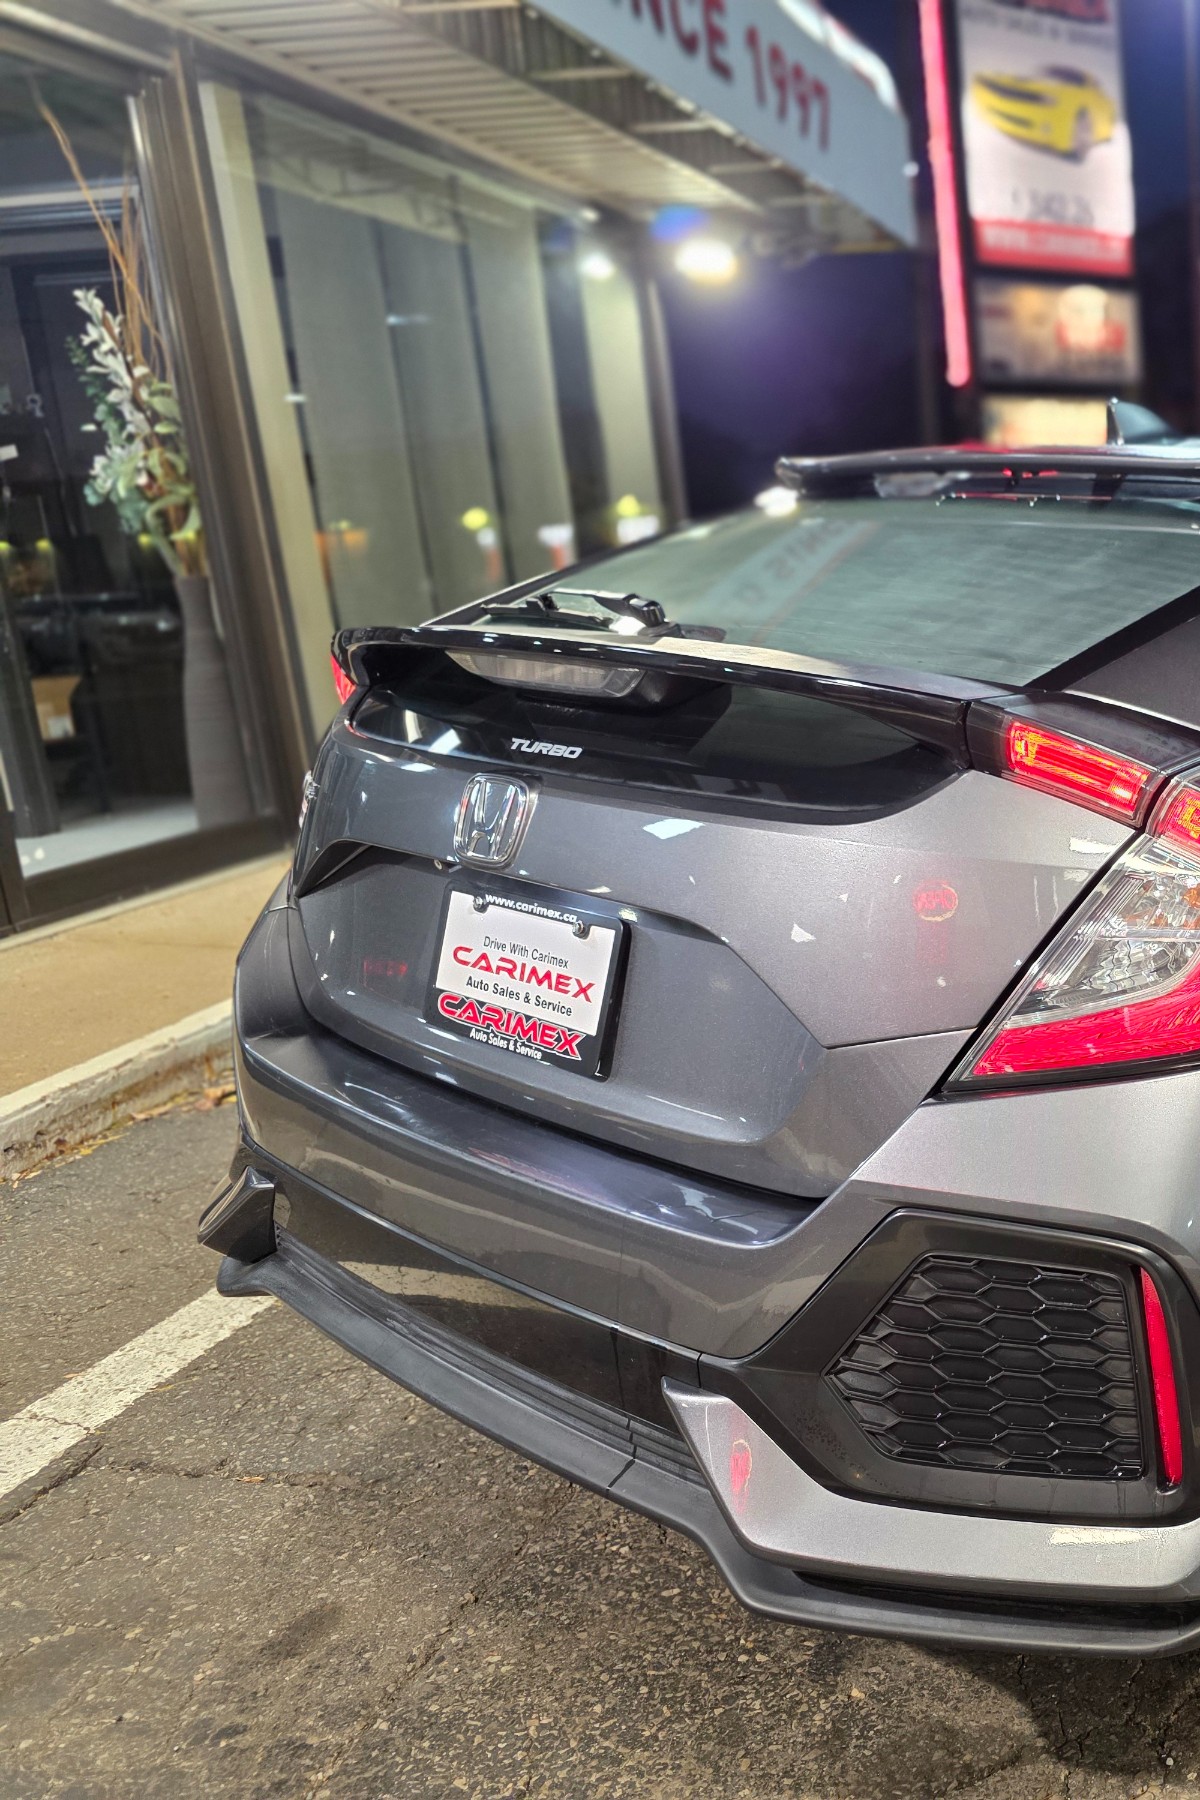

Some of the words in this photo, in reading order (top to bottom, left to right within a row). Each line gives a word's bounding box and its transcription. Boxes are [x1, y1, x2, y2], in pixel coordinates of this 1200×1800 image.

[746, 25, 831, 151] 1997
[511, 737, 583, 759] TURBO
[485, 894, 577, 923] www.carimex.ca
[483, 935, 507, 952] Drive
[509, 941, 529, 959] With
[531, 948, 569, 969] Carimex
[453, 946, 596, 1003] CARIMEX
[466, 976, 489, 992] Auto
[492, 983, 521, 1001] Sales
[523, 992, 531, 1005] &
[534, 995, 573, 1017] Service
[439, 992, 584, 1059] CARIMEX
[469, 1028, 488, 1042] Auto
[488, 1033, 508, 1049] Sales
[508, 1040, 515, 1052] &
[515, 1042, 542, 1060] Service
